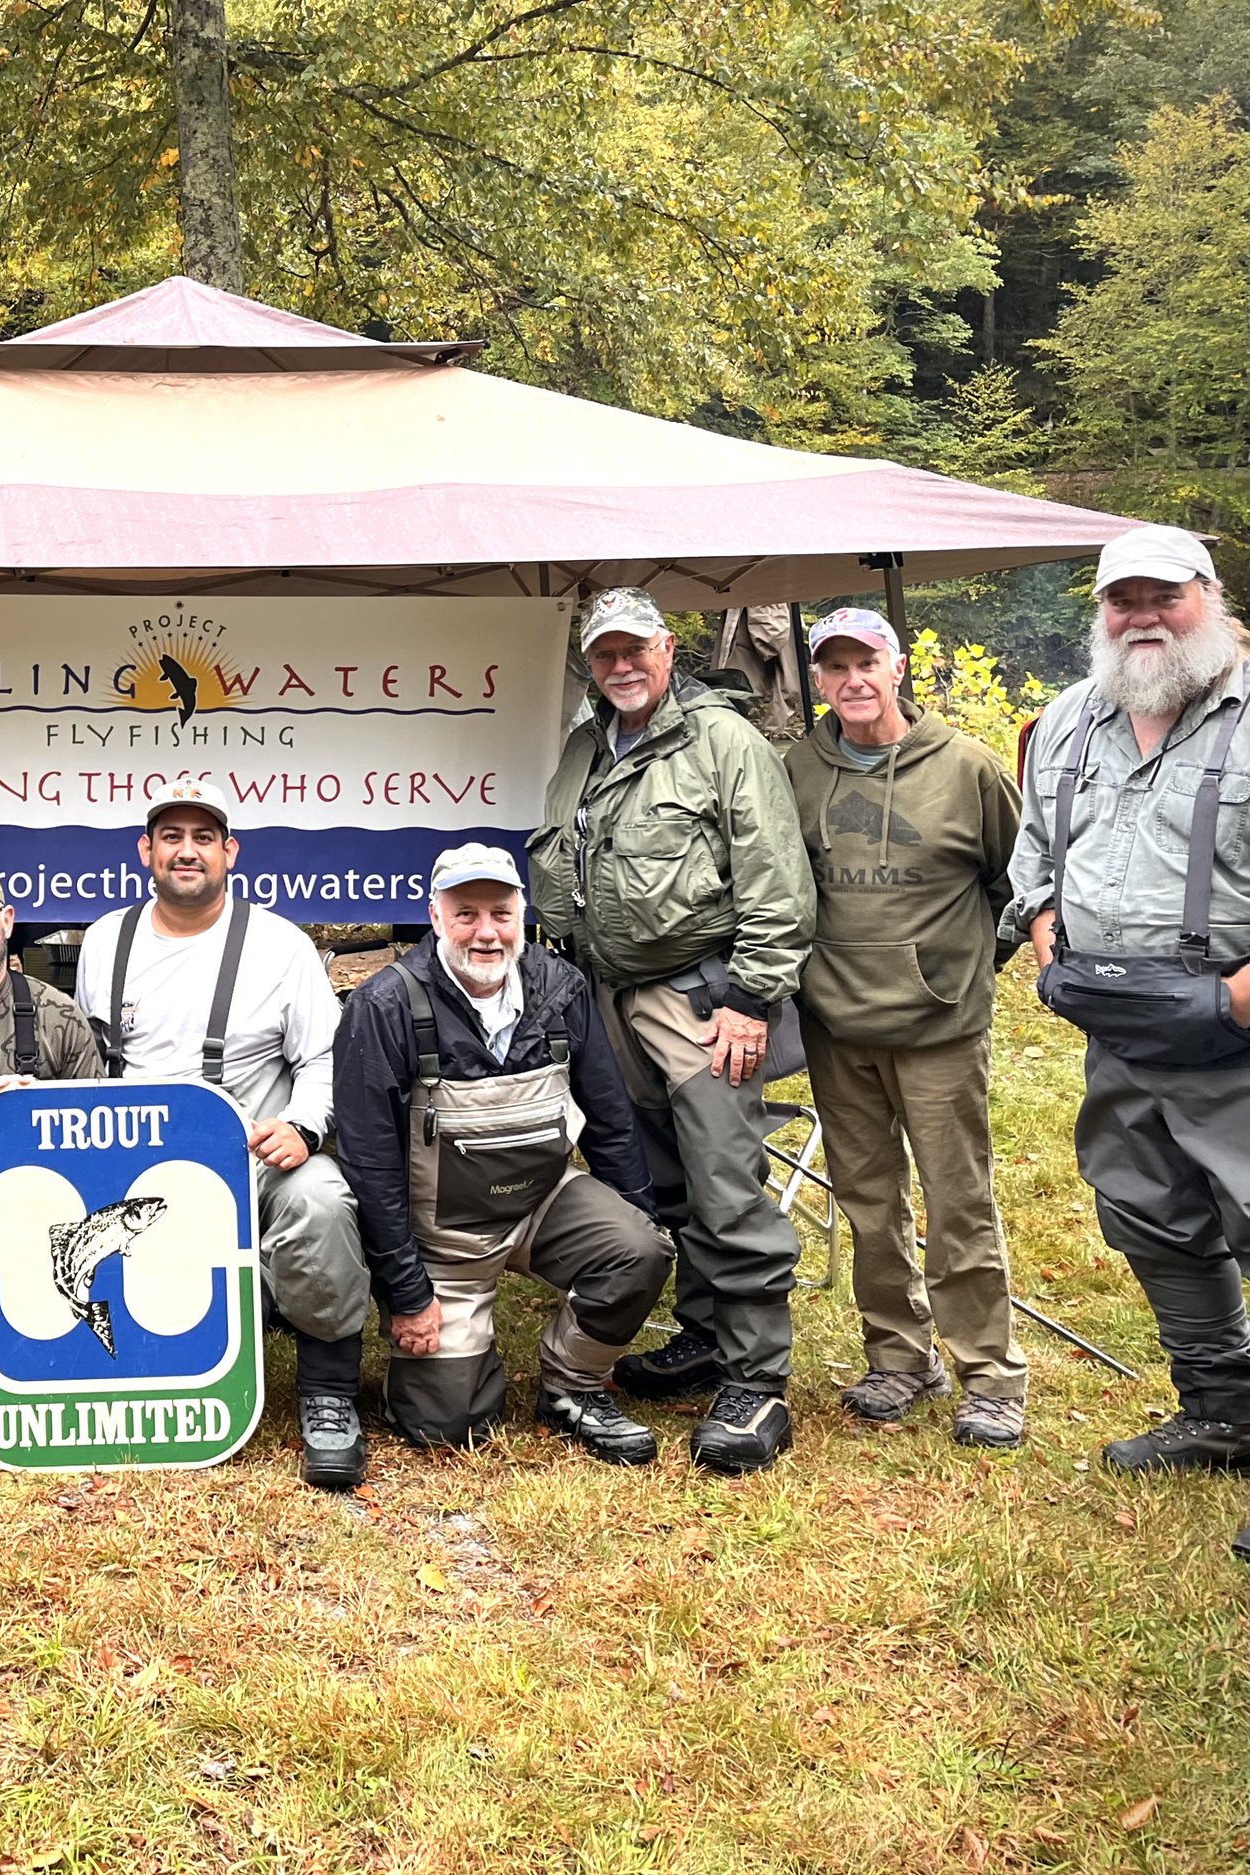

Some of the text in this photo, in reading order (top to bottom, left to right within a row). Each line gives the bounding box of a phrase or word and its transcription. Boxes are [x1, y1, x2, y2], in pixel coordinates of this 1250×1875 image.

[128, 614, 227, 639] PROJECT
[213, 663, 499, 700] WATERS
[78, 770, 213, 803] THO
[228, 771, 342, 804] WHO
[362, 771, 498, 805] SERVE
[31, 1104, 169, 1150] TROUT
